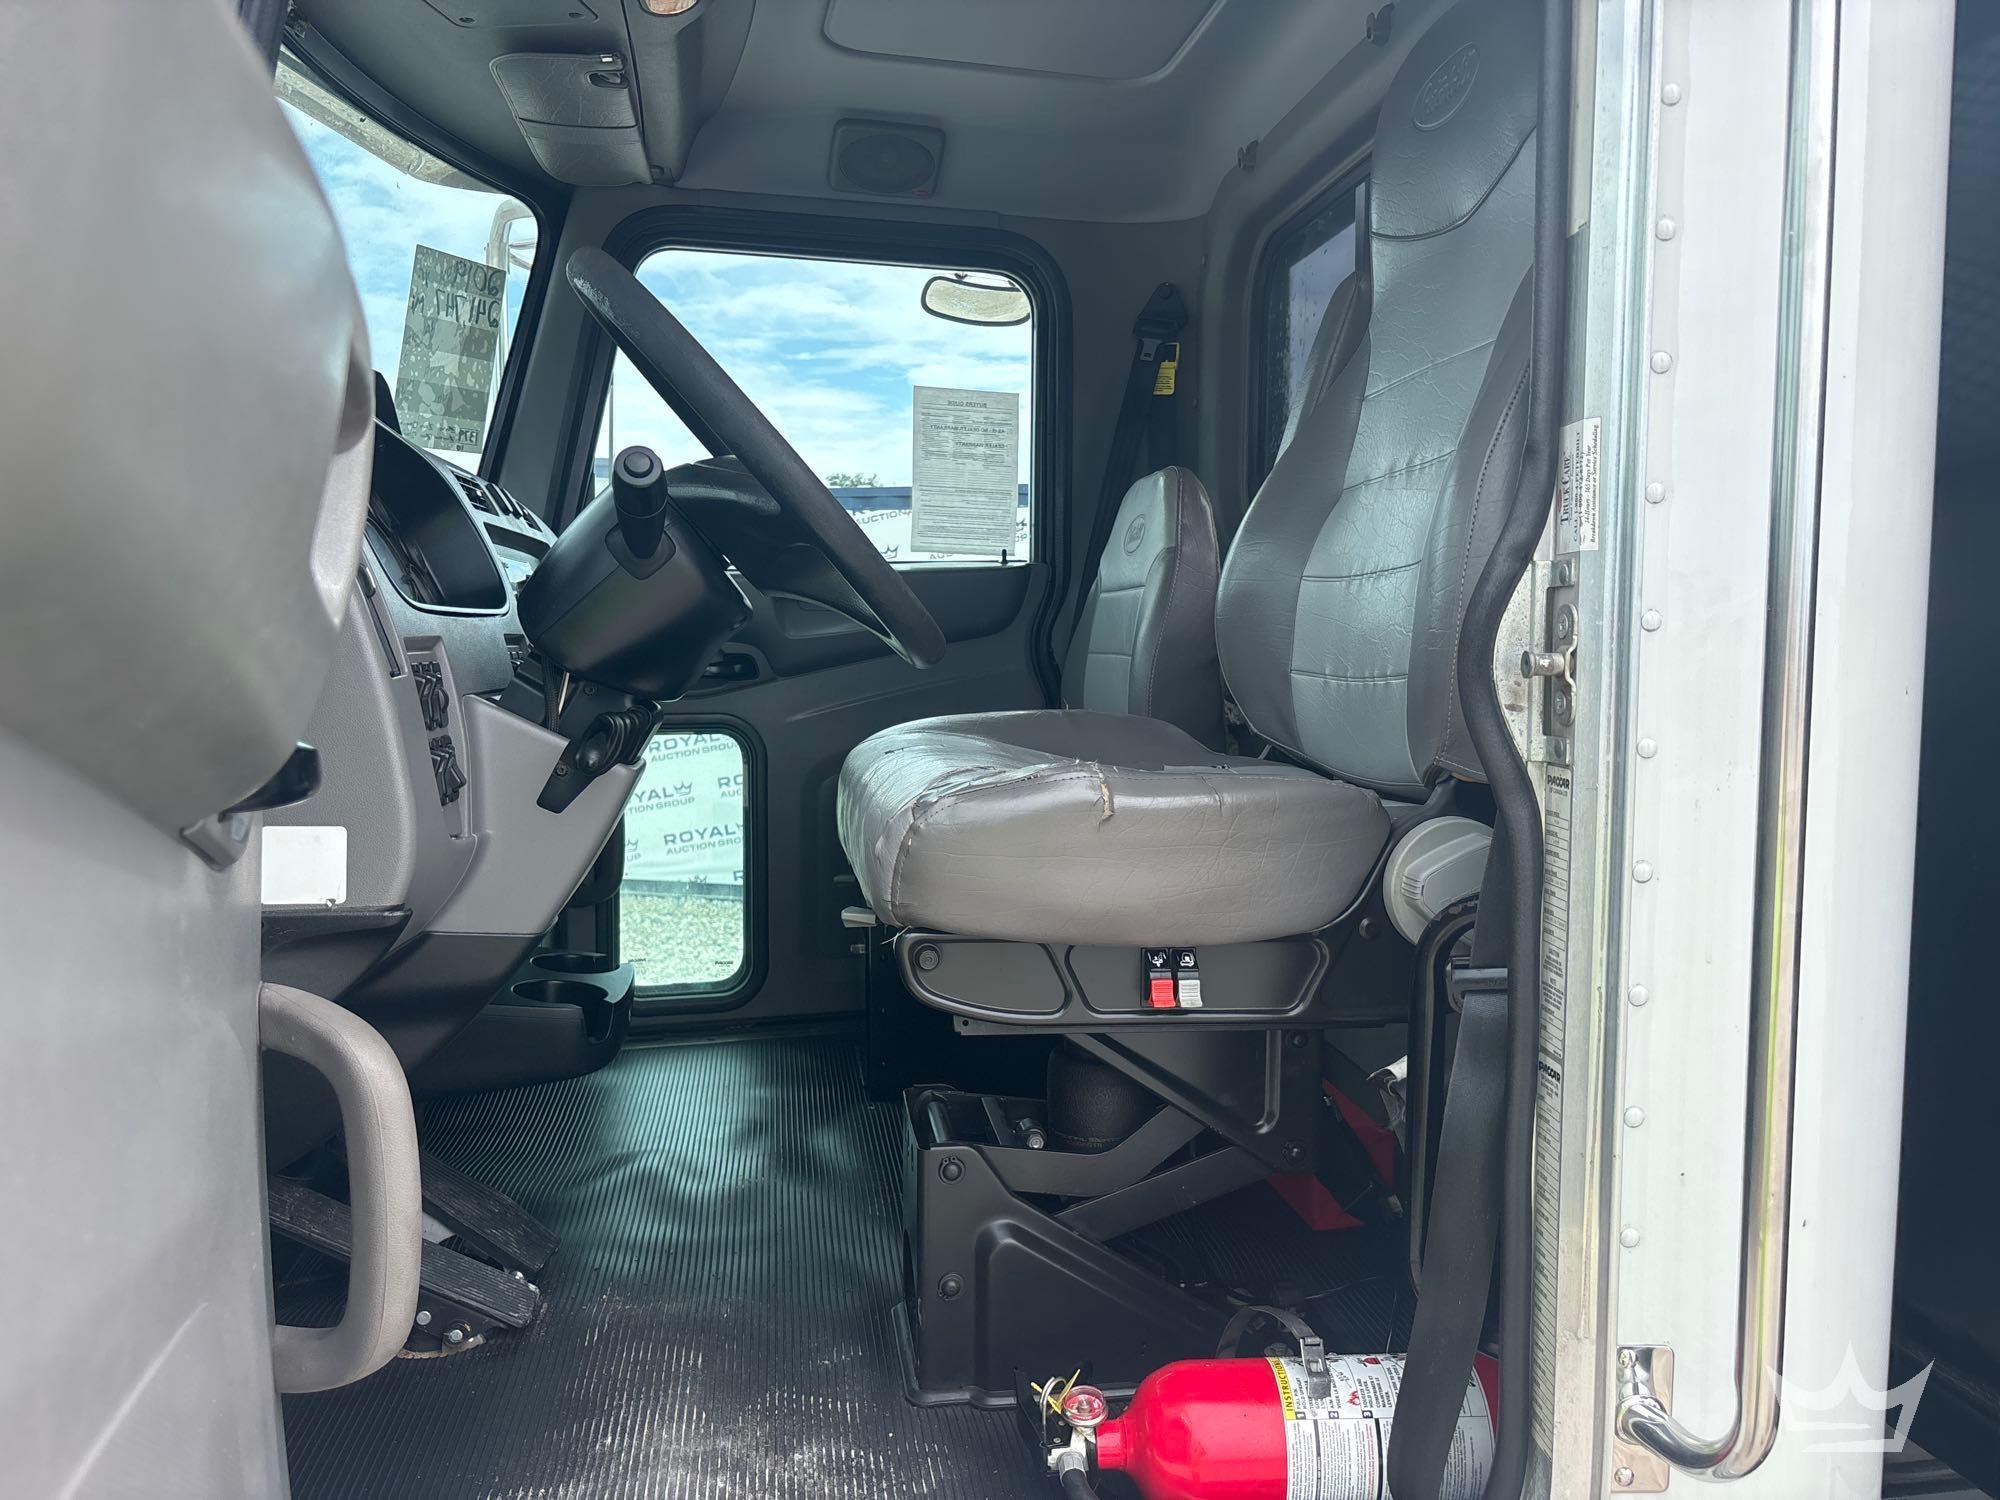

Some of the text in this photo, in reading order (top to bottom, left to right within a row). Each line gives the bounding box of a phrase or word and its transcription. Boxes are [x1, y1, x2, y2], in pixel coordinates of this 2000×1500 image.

[1560, 487, 1570, 526] TRUCK
[648, 734, 721, 754] ROYAL
[651, 741, 738, 763] AUCTION GROU
[1547, 775, 1570, 790] PACCAR
[656, 796, 695, 810] GROUP
[664, 824, 736, 846] ROYAL
[667, 836, 742, 856] AUCTION GRO
